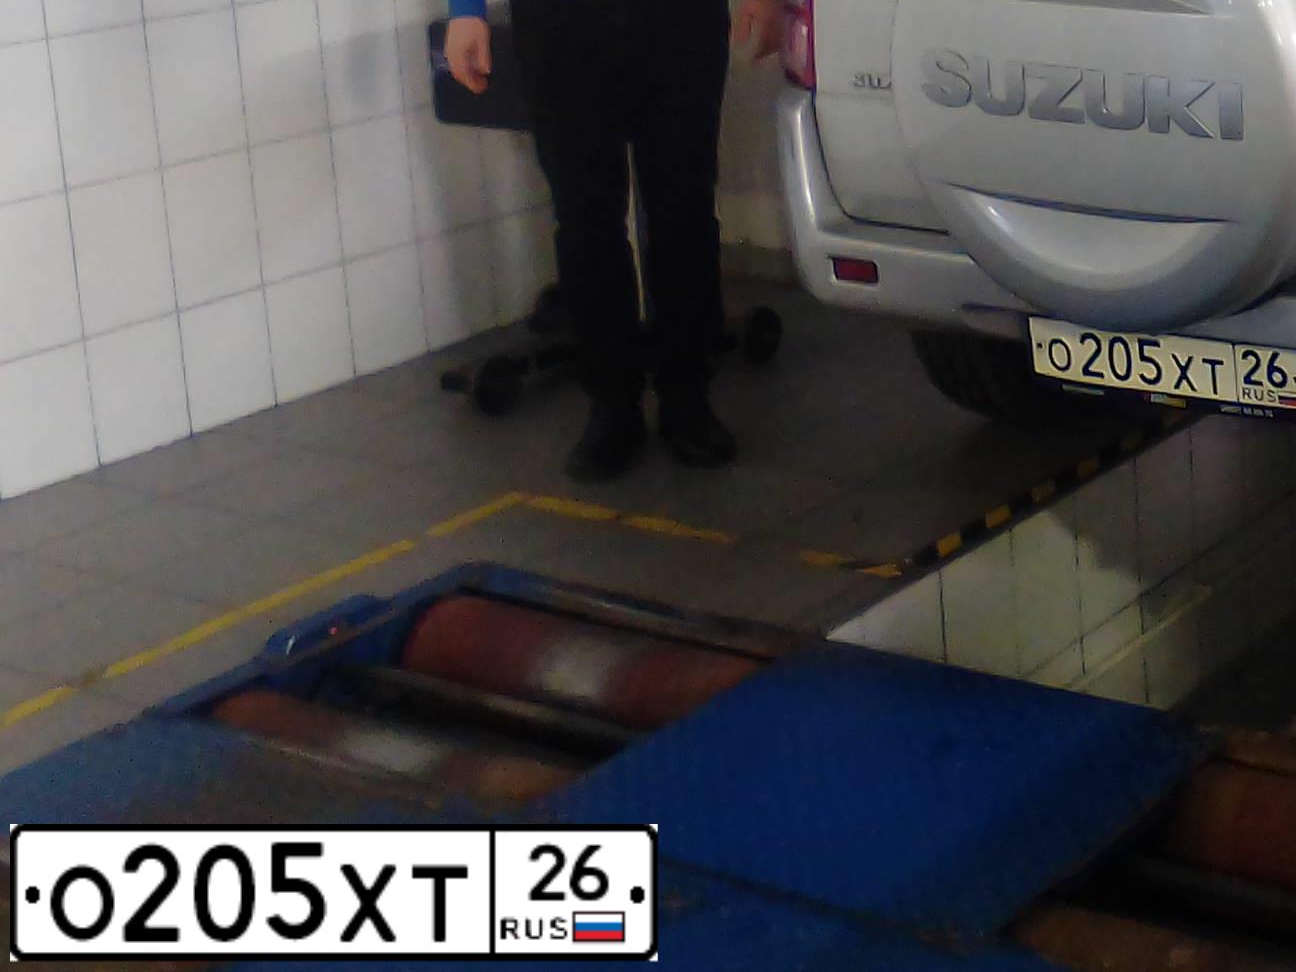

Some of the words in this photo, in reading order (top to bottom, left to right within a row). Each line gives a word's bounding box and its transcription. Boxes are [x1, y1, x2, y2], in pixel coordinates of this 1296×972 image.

[921, 49, 1244, 141] SUZUKI
[1241, 349, 1288, 388] 26
[1241, 387, 1279, 403] RUS
